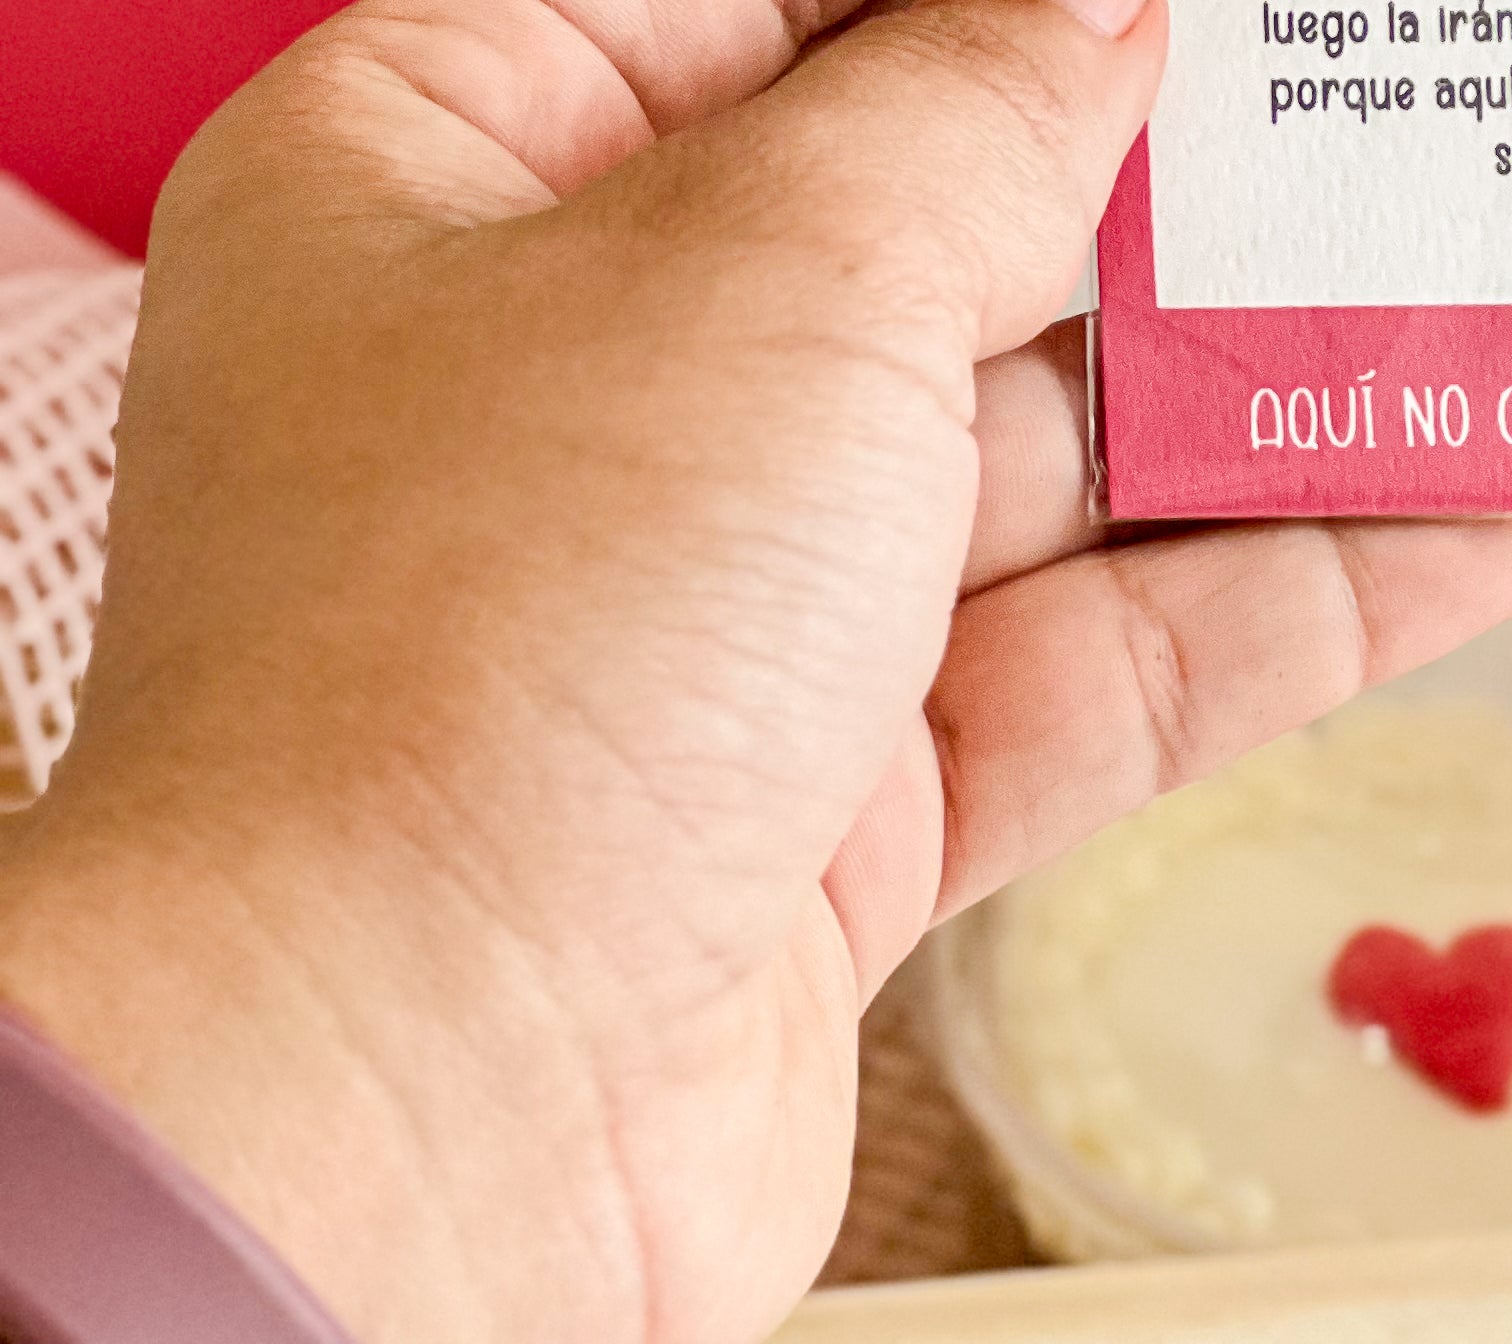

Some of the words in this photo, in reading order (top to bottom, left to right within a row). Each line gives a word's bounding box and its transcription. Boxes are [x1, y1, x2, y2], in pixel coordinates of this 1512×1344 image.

[1264, 1, 1368, 58] luego
[1388, 1, 1420, 43] la
[1271, 77, 1415, 124] porque
[1250, 368, 1377, 451] AQUÍ
[1402, 383, 1471, 449] NO
